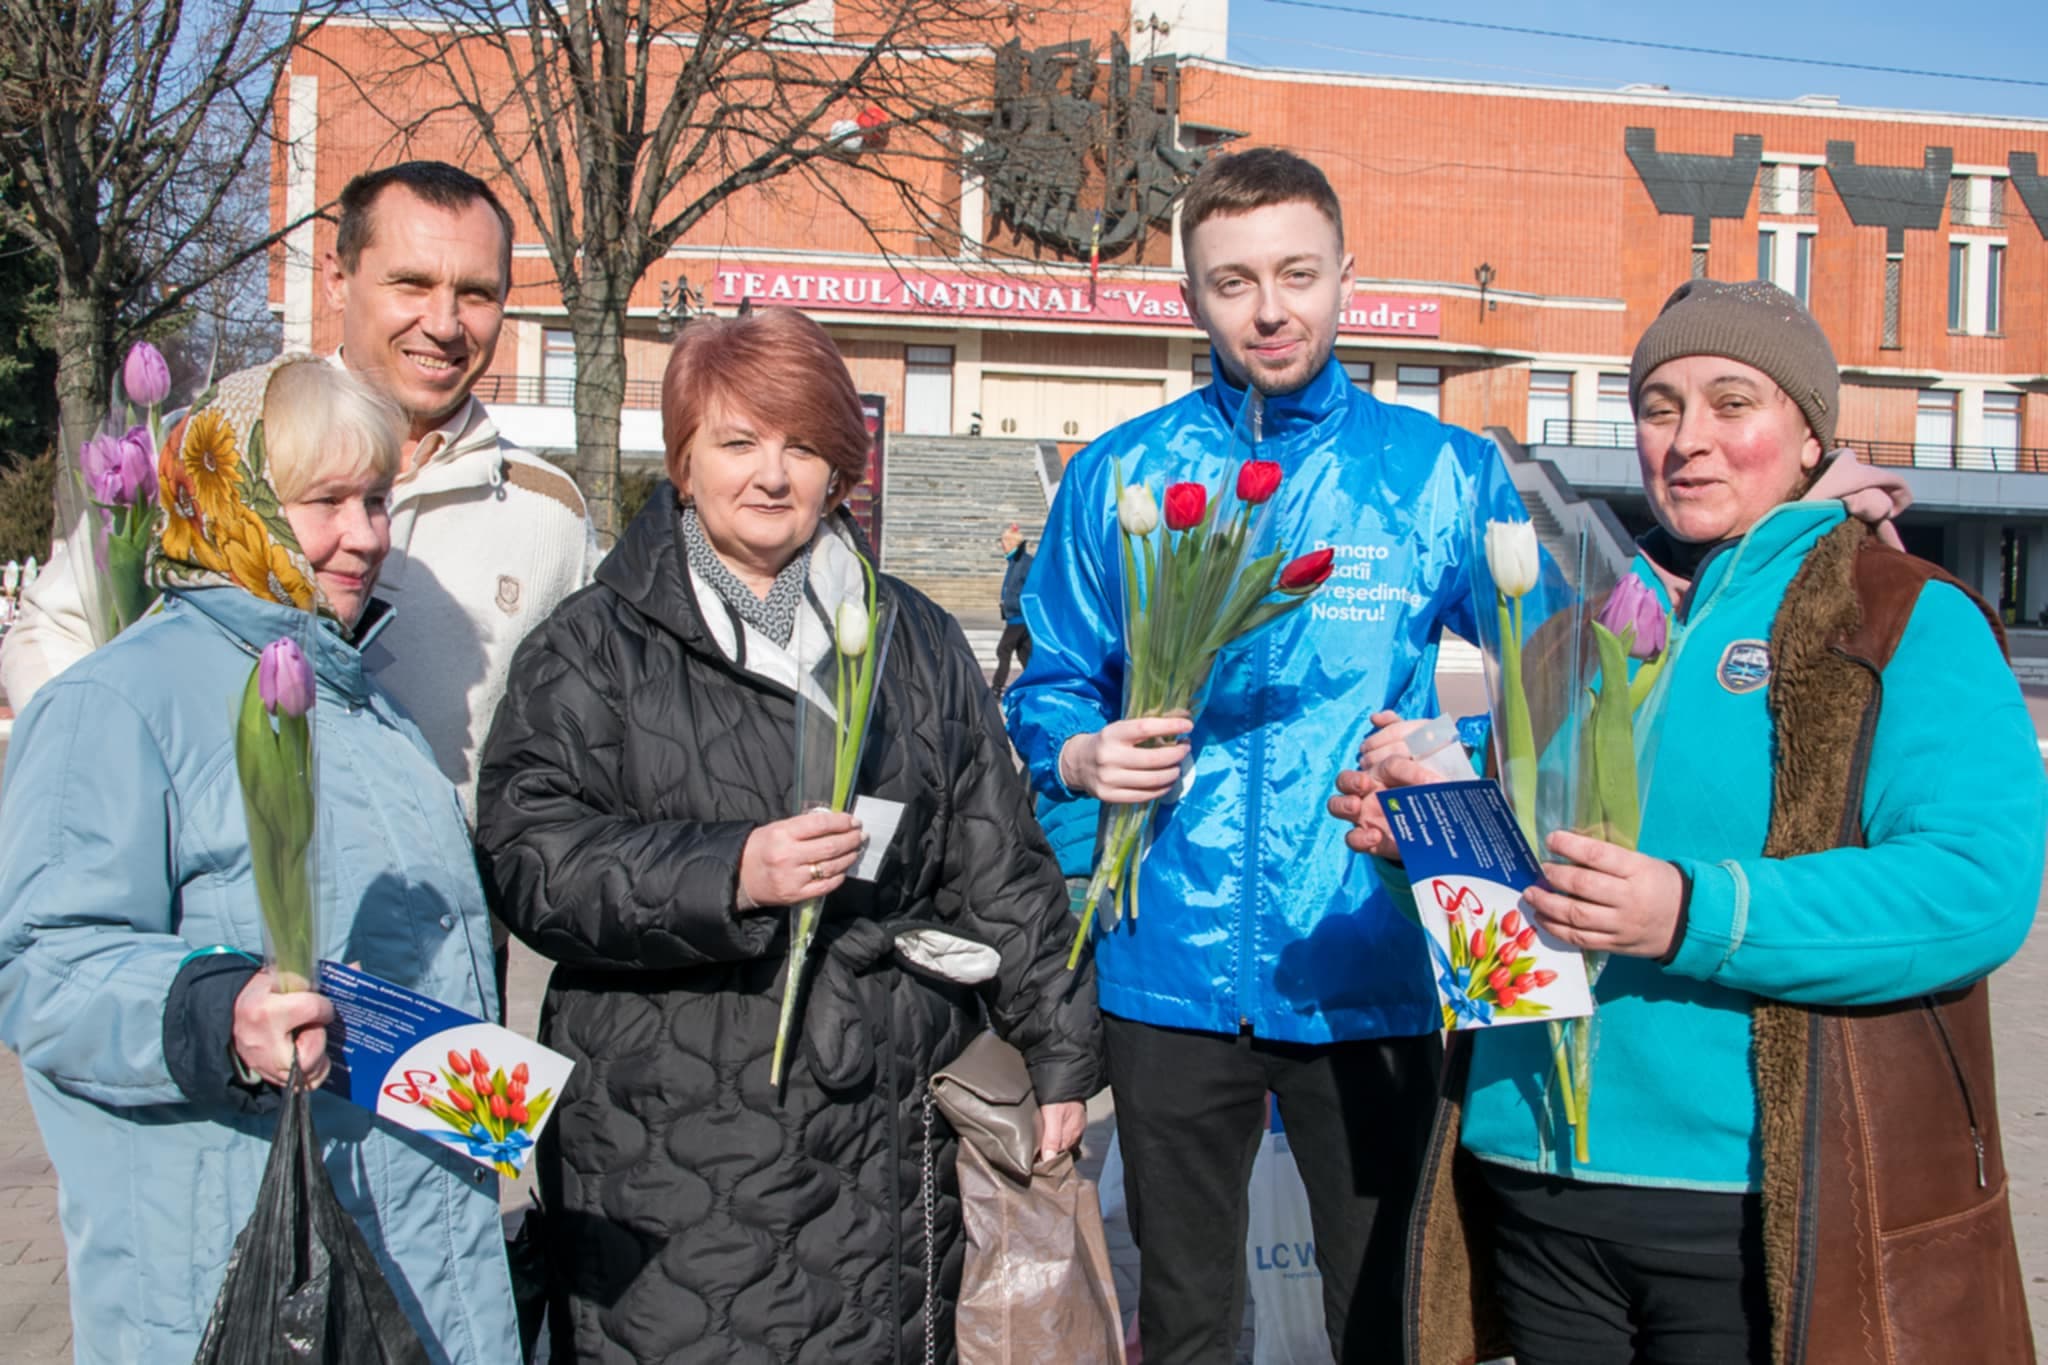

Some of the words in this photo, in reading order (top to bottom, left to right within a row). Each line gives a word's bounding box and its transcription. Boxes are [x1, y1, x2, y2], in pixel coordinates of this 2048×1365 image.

[719, 271, 891, 304] TEATRUL
[902, 281, 1092, 314] NAȚIONAL
[1311, 602, 1385, 622] Nostru!
[1256, 1243, 1290, 1270] LC
